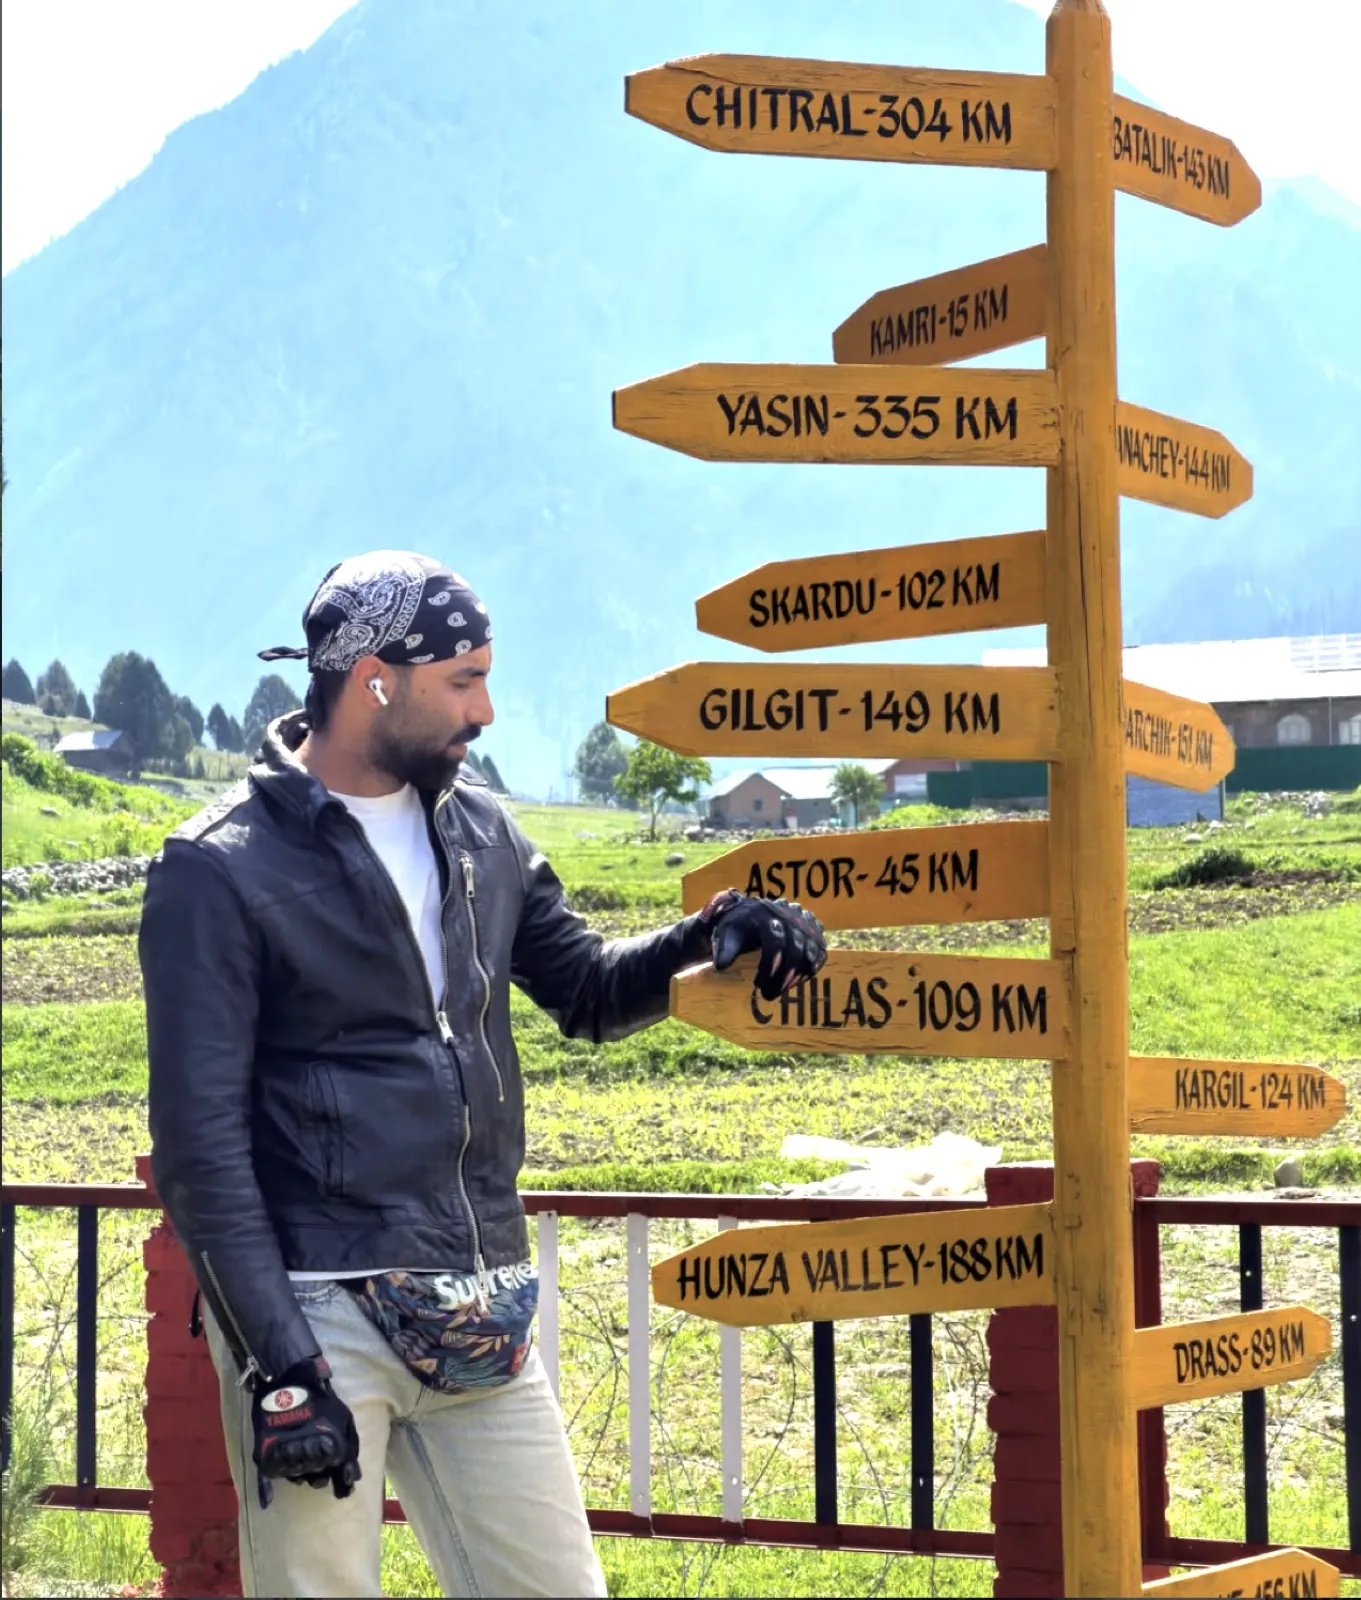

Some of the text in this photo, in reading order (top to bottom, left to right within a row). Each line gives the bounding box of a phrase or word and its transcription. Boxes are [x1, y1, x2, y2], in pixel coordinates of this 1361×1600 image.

[684, 83, 1012, 145] CHITRAL-304 KM
[1207, 154, 1230, 199] KM
[870, 284, 1008, 358] KAMRI-15 KM
[955, 396, 1018, 441] KM
[1211, 453, 1231, 493] KM
[748, 562, 1000, 628] SKARDU-102 KM
[944, 691, 1000, 735] KM
[1123, 707, 1193, 763] ARCHIK-151
[928, 848, 979, 893] KM
[991, 983, 1048, 1035] KM
[1175, 1067, 1326, 1110] KARGIL-124 KM
[676, 1232, 1044, 1301] HUNZA VALLEY-188 KM
[1172, 1322, 1305, 1384] DRASS-89 KM
